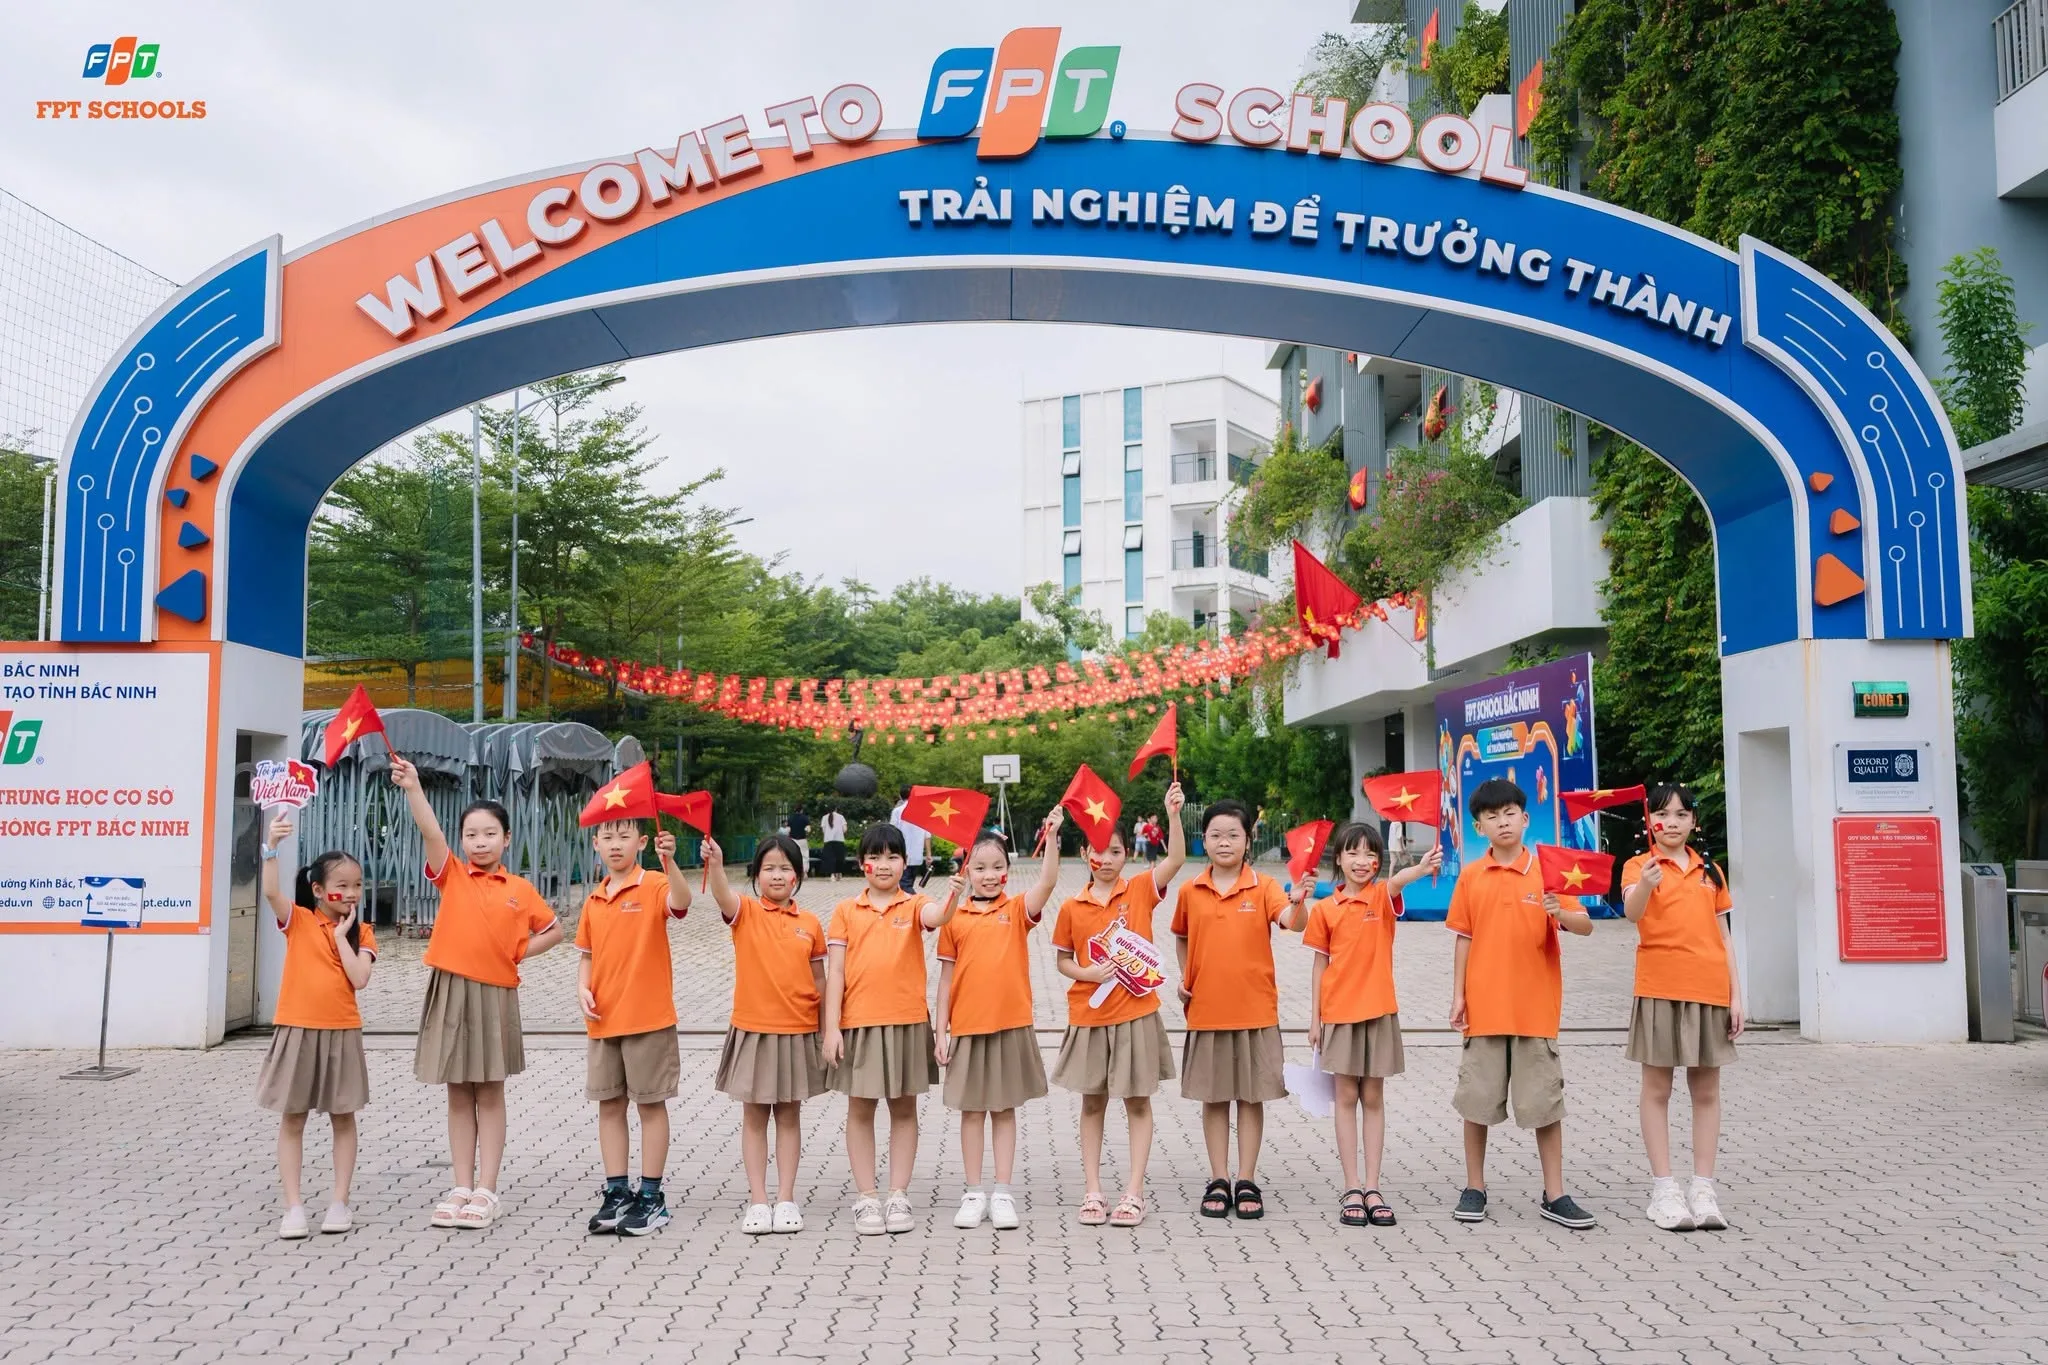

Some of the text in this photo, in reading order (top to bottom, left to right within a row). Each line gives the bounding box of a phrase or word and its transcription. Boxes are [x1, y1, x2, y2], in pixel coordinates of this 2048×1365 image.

[1171, 82, 1529, 189] SCHOOL
[356, 83, 883, 339] WELCOME TO
[899, 176, 1732, 347] TRẢI NGHIỆM ĐỂ TRƯỞNG THÀNH
[3, 660, 80, 677] BẮC NINH
[3, 682, 157, 702] TẠO TỈNH BẮC NINH
[1896, 693, 1903, 706] 1
[1853, 757, 1889, 766] OXFORD
[1853, 766, 1889, 775] QUALITY
[280, 778, 309, 799] Nam
[66, 789, 109, 808] HỌC
[0, 815, 190, 837] HÔNG FPT BẮC NINH
[0, 877, 27, 891] ường
[29, 878, 53, 889] Kinh
[0, 897, 33, 907] edu.vn
[1111, 949, 1145, 975] 2/9
